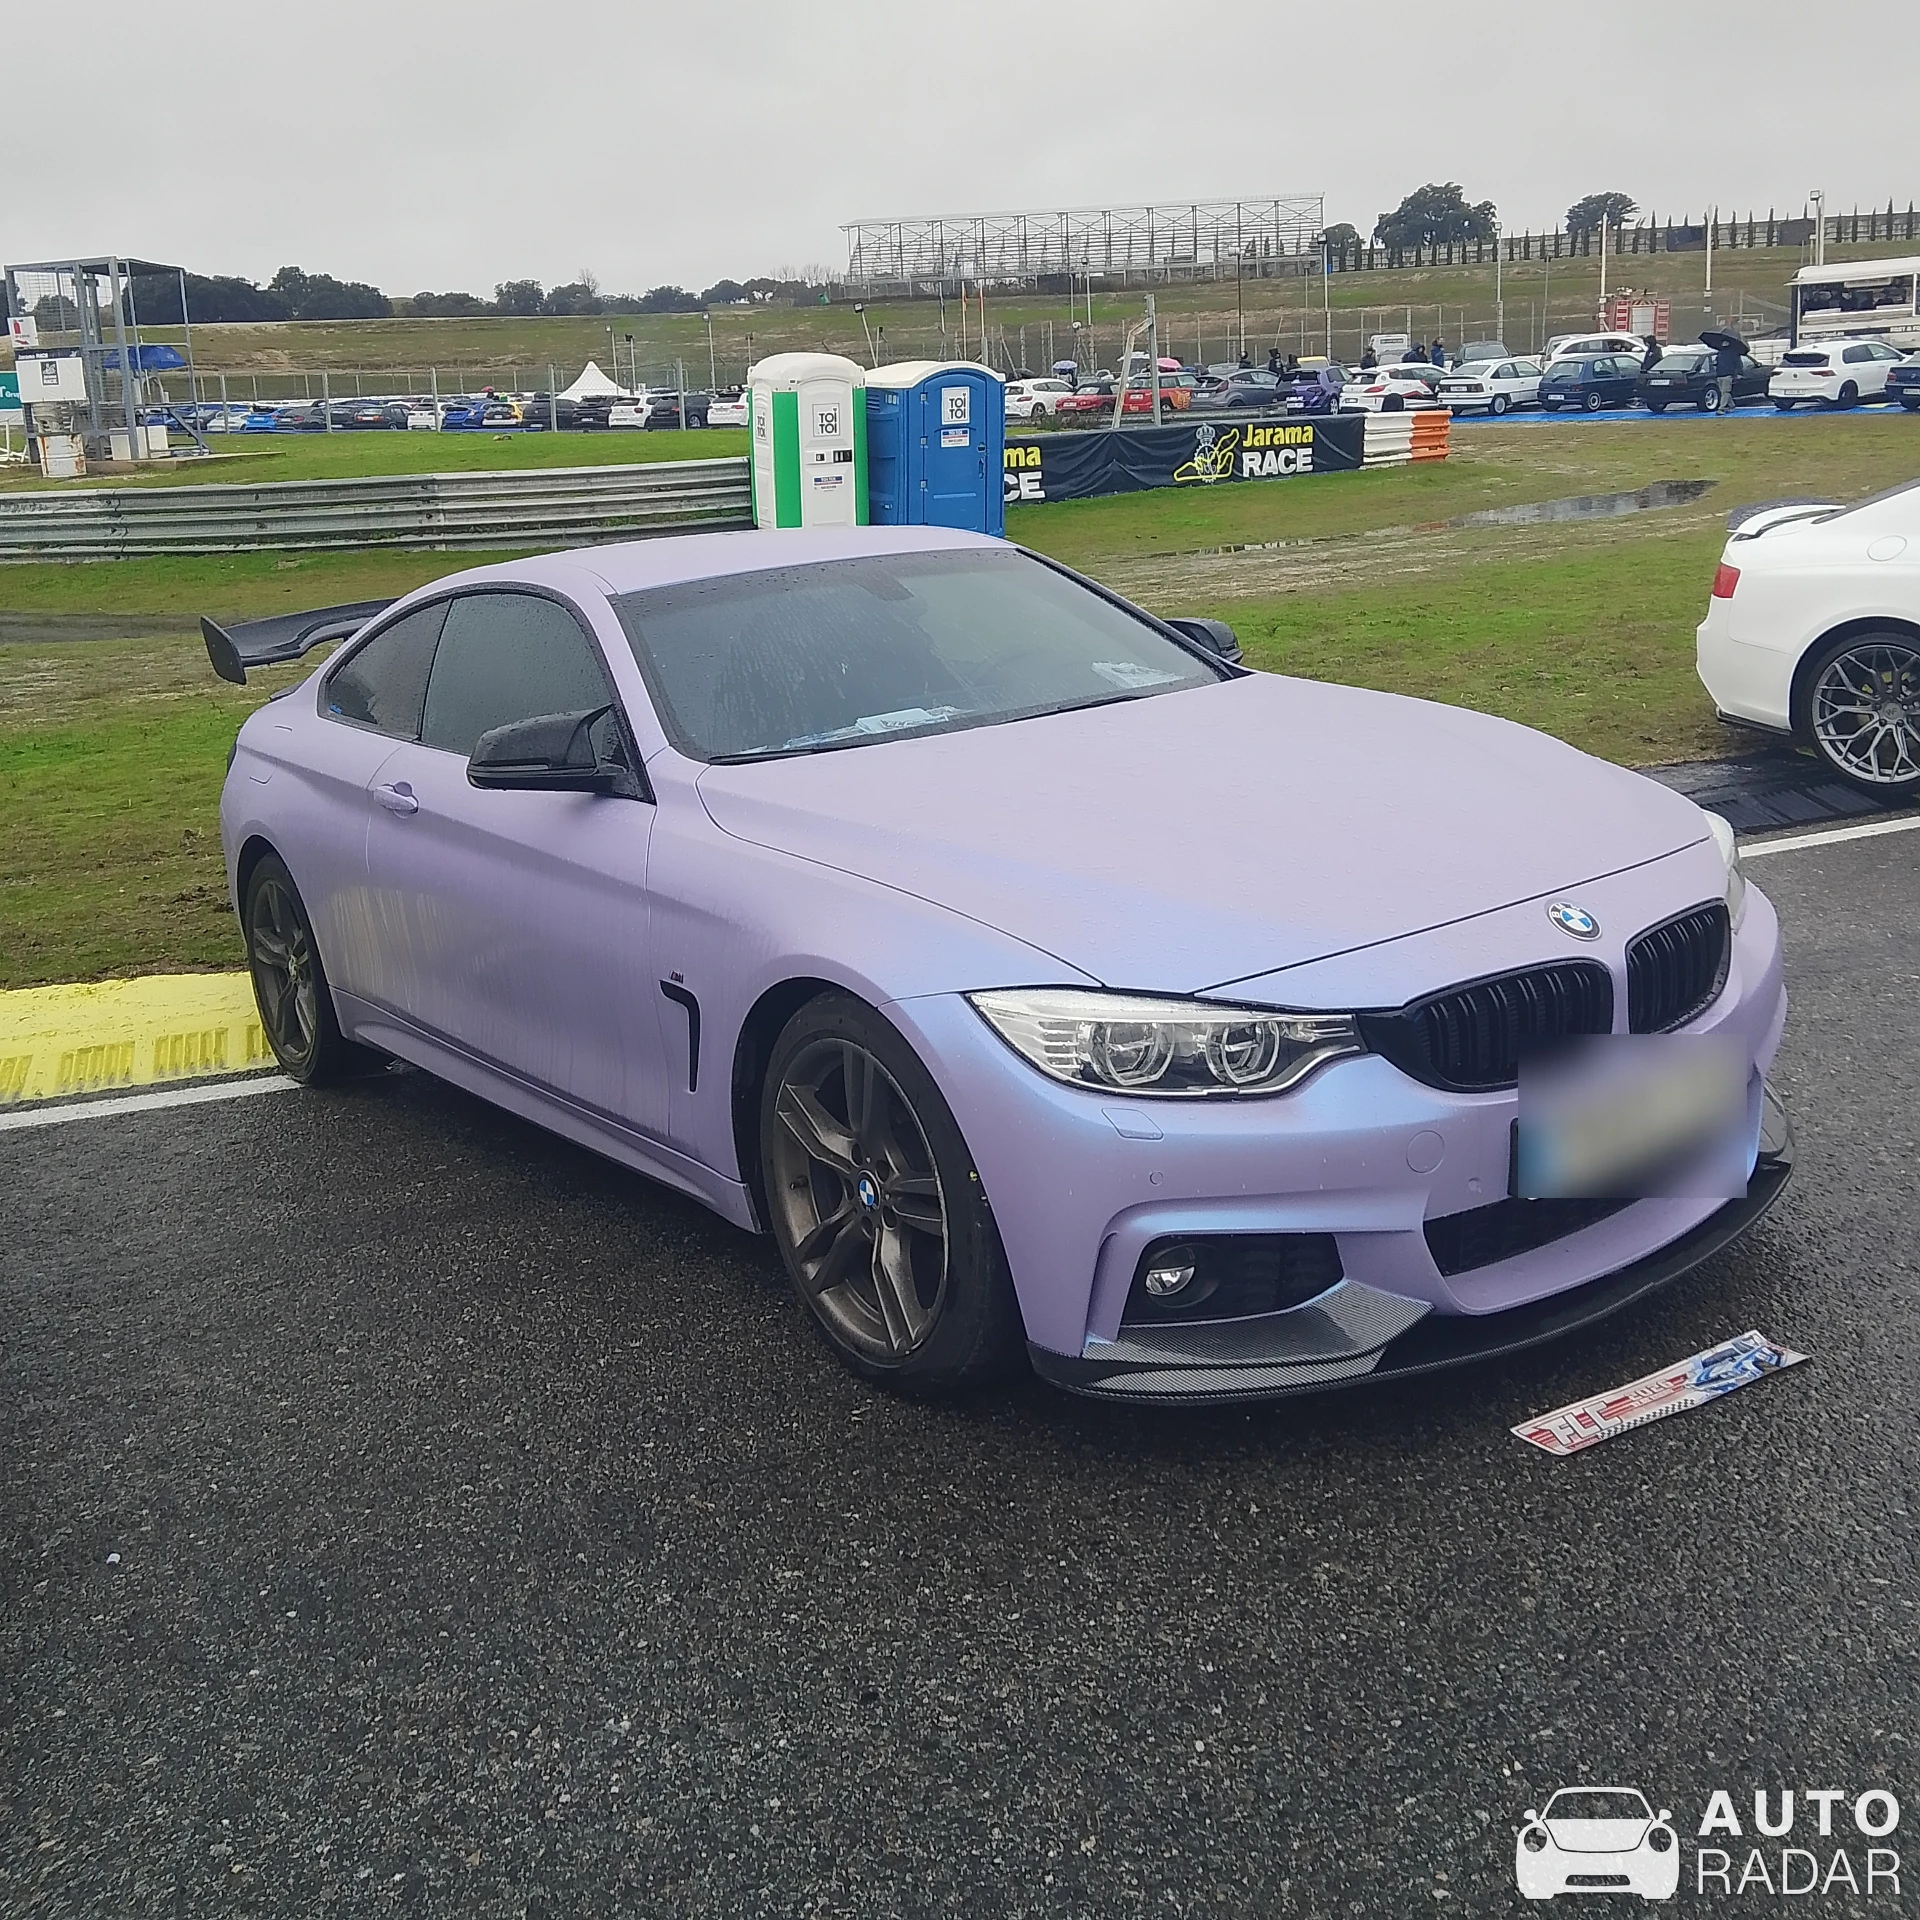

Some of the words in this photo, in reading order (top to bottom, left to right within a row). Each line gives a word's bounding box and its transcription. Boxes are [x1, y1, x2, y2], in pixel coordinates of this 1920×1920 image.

[948, 408, 966, 419] TOI
[818, 423, 837, 434] TOI
[1242, 424, 1313, 447] Jarama
[1242, 448, 1313, 477] RACE
